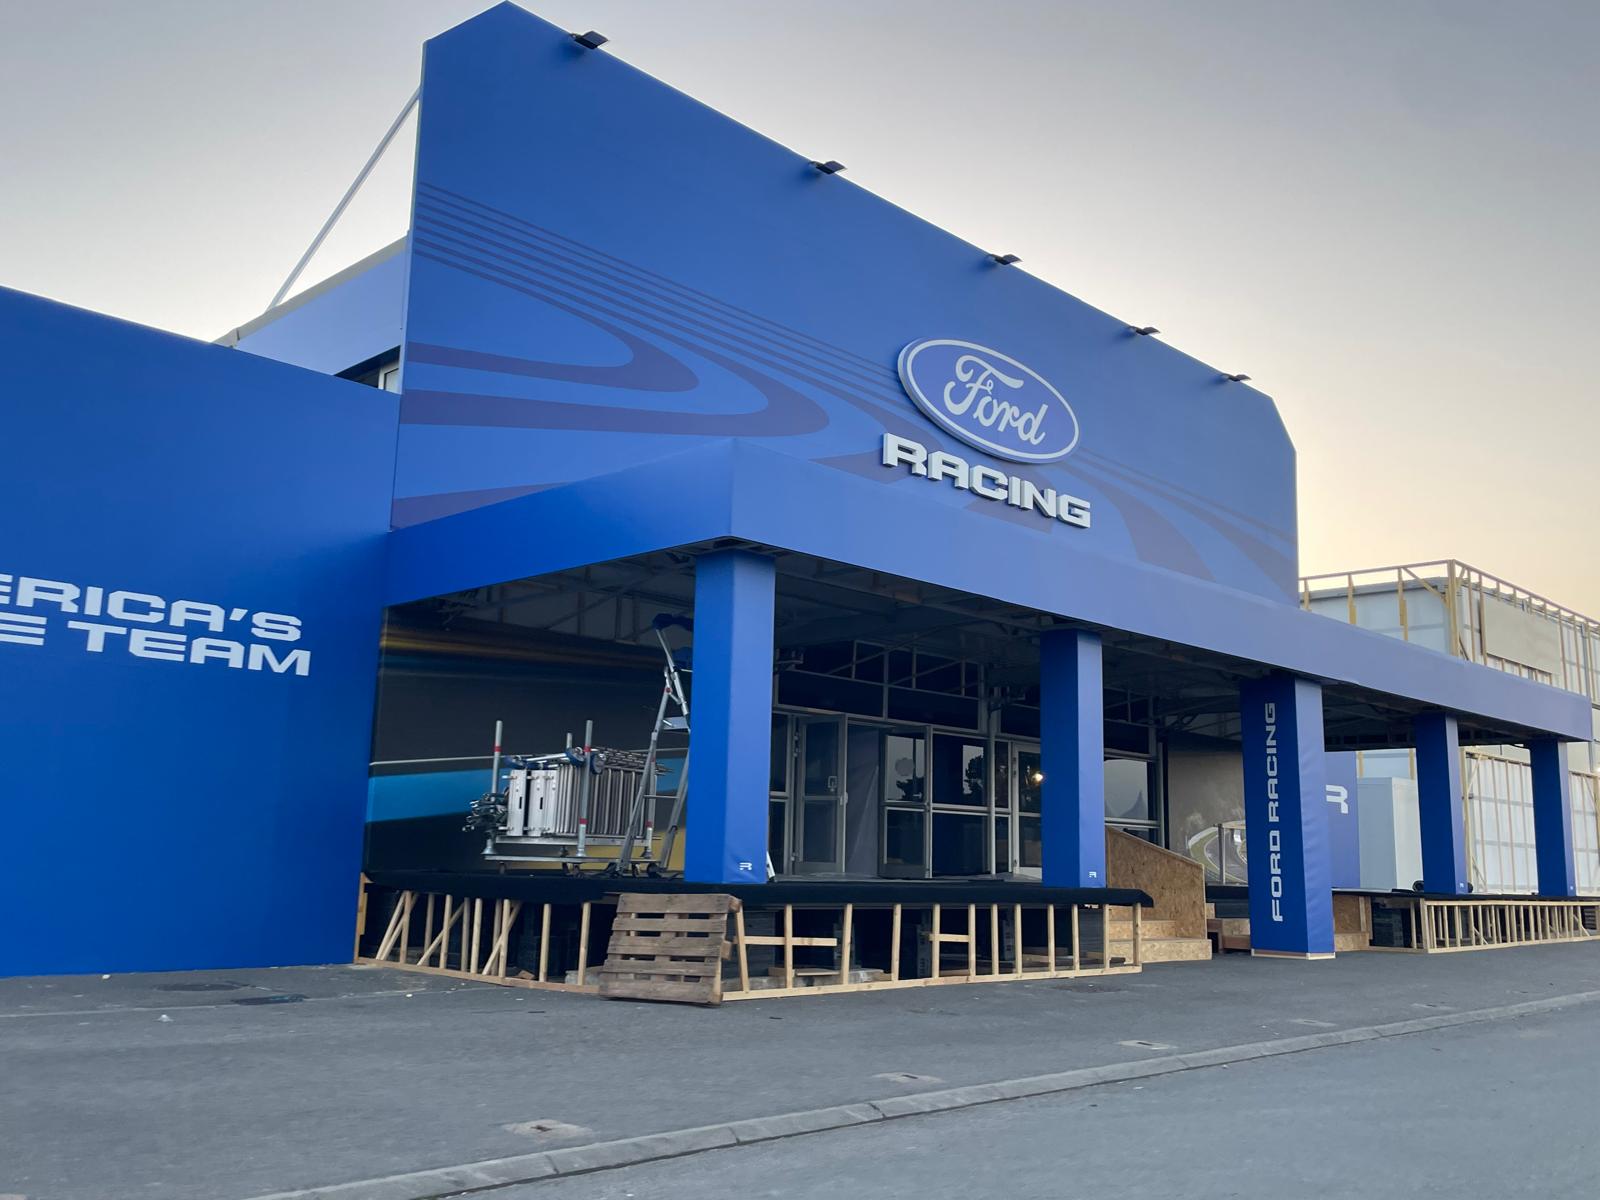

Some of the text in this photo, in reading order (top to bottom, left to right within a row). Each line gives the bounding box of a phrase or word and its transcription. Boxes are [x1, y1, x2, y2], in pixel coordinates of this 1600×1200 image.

[943, 354, 1049, 445] Ford
[882, 432, 1091, 528] RACING
[0, 573, 303, 642] RICA'S
[67, 620, 312, 677] TEAM
[1264, 702, 1284, 922] FORD RACING
